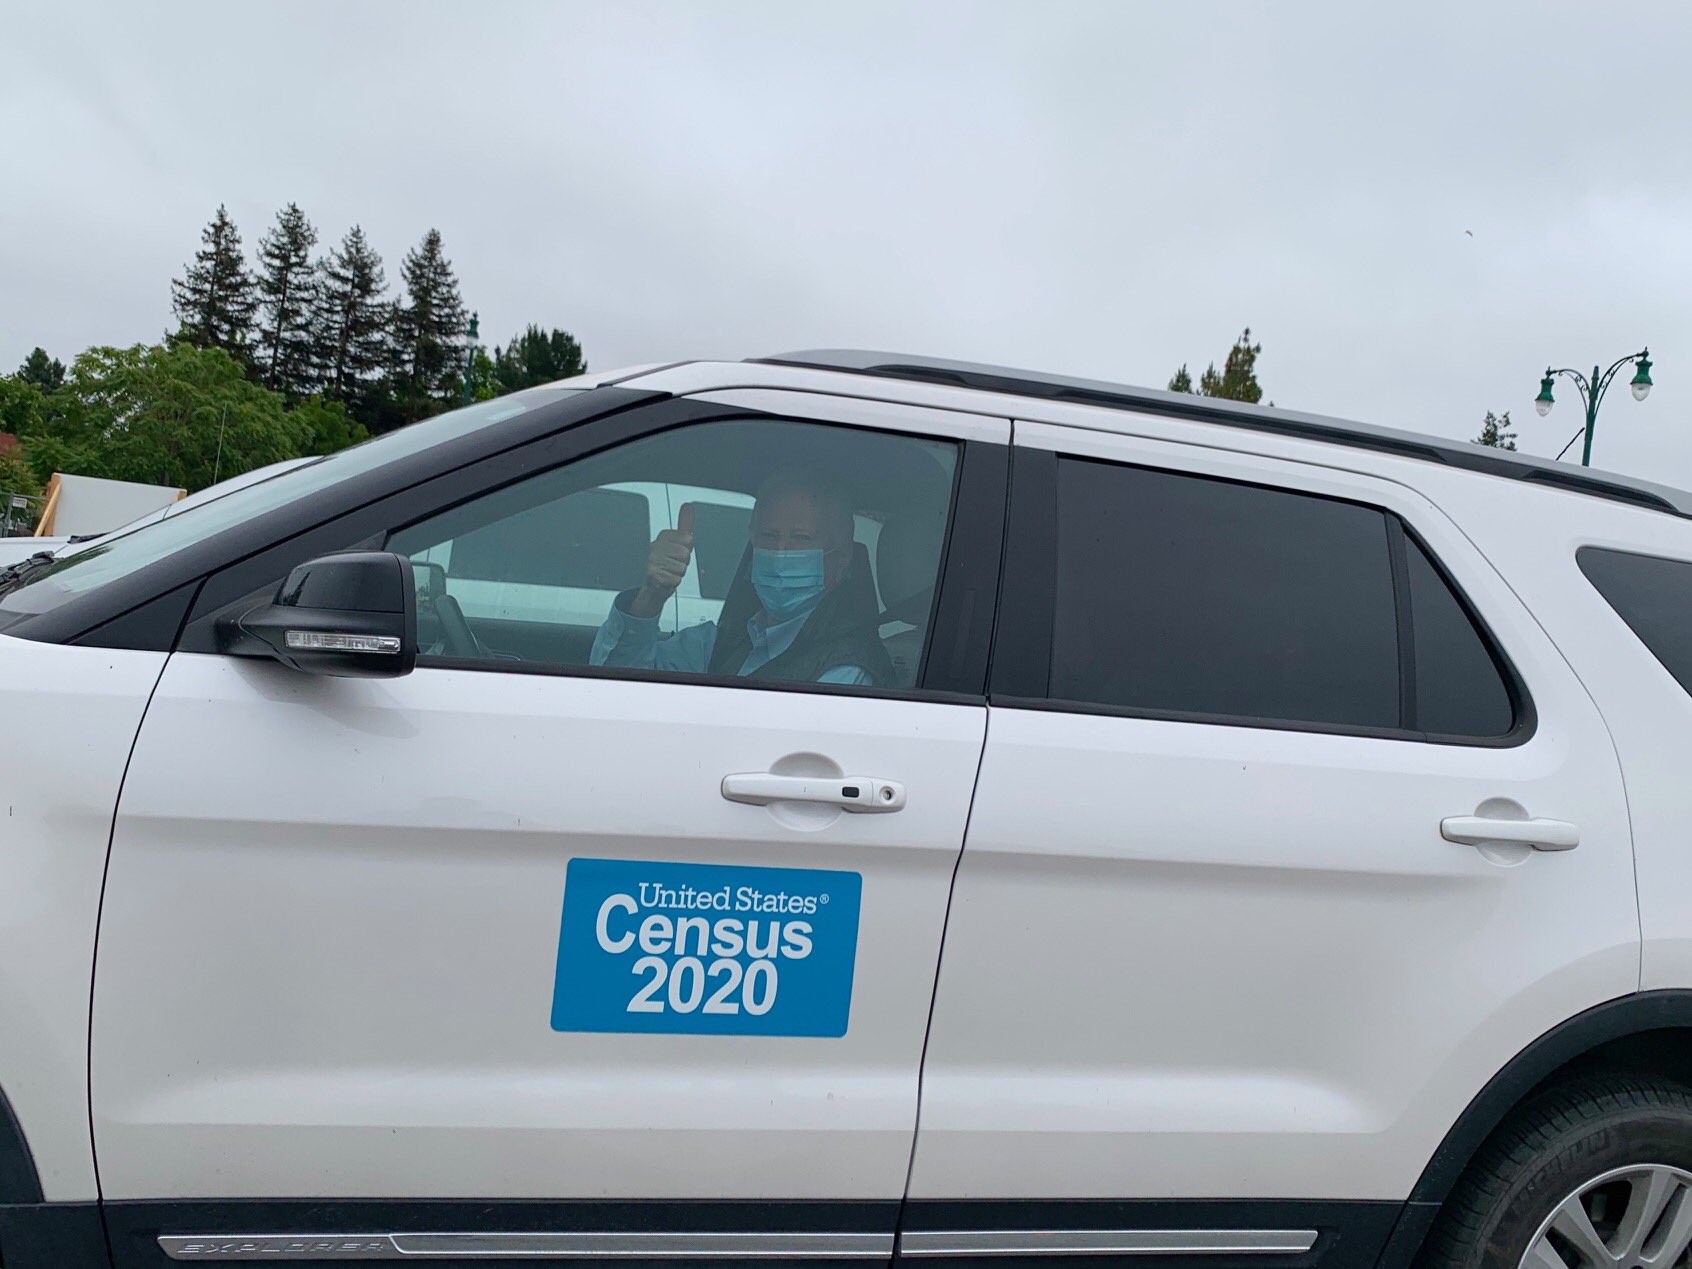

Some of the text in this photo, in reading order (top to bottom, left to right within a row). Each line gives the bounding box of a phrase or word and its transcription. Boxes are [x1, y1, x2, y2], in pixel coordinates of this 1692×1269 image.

[595, 893, 814, 960] Census
[638, 882, 731, 911] United
[626, 956, 778, 1016] 2020
